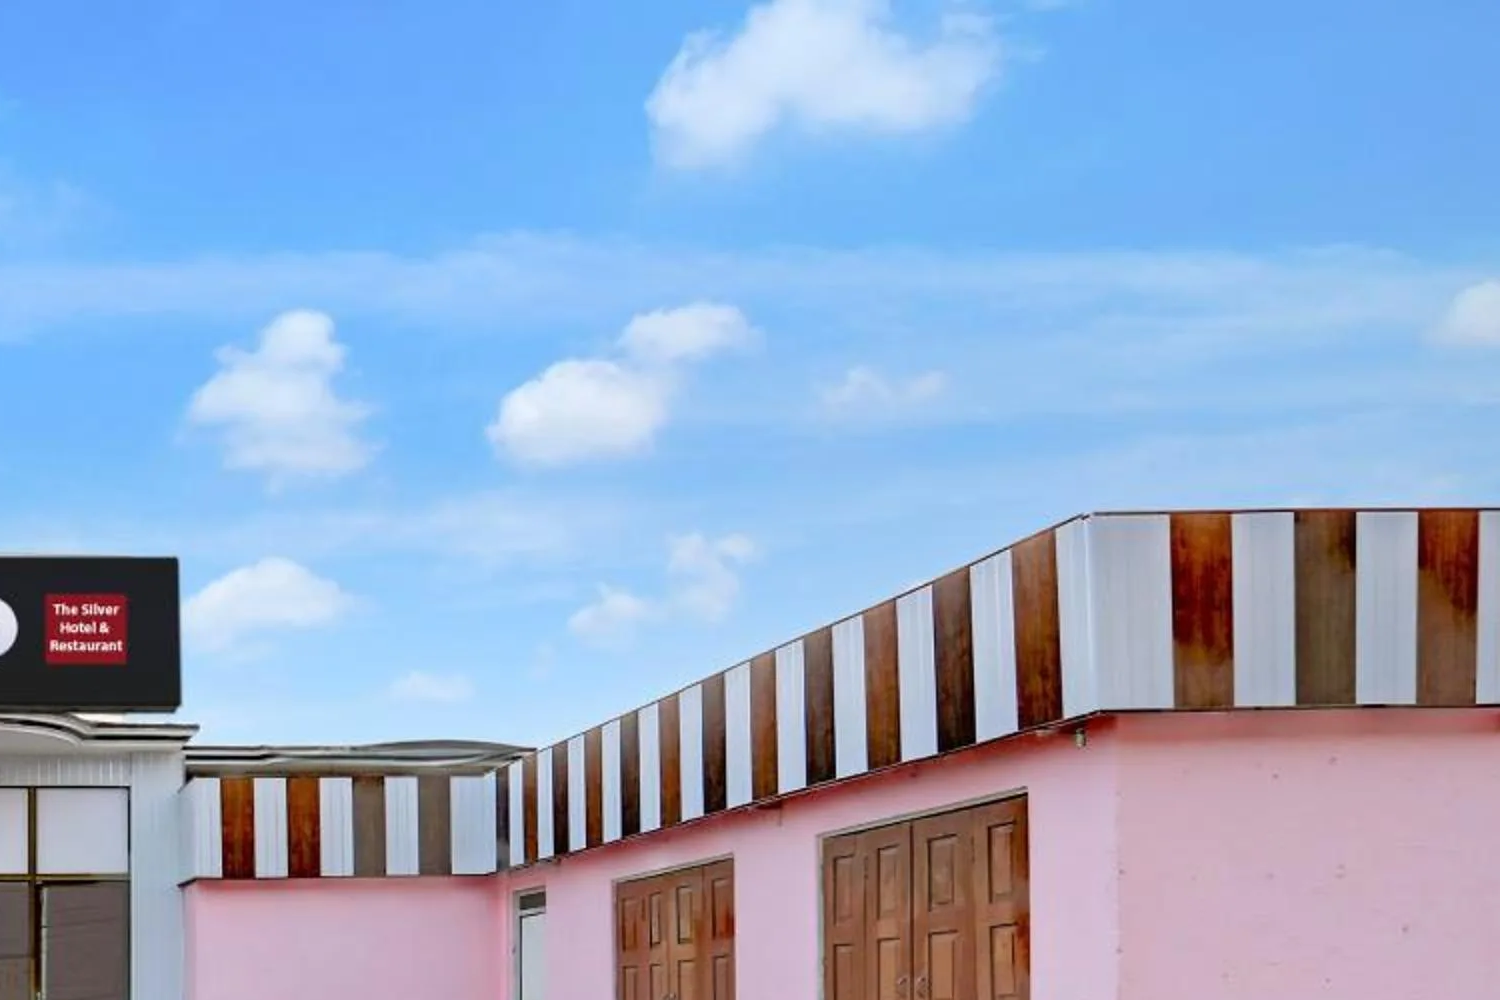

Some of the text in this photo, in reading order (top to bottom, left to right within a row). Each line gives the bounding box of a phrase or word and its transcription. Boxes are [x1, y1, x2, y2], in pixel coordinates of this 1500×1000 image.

[52, 602, 120, 615] The Silver
[59, 621, 110, 633] Hotel &
[49, 639, 123, 651] Restaurant
